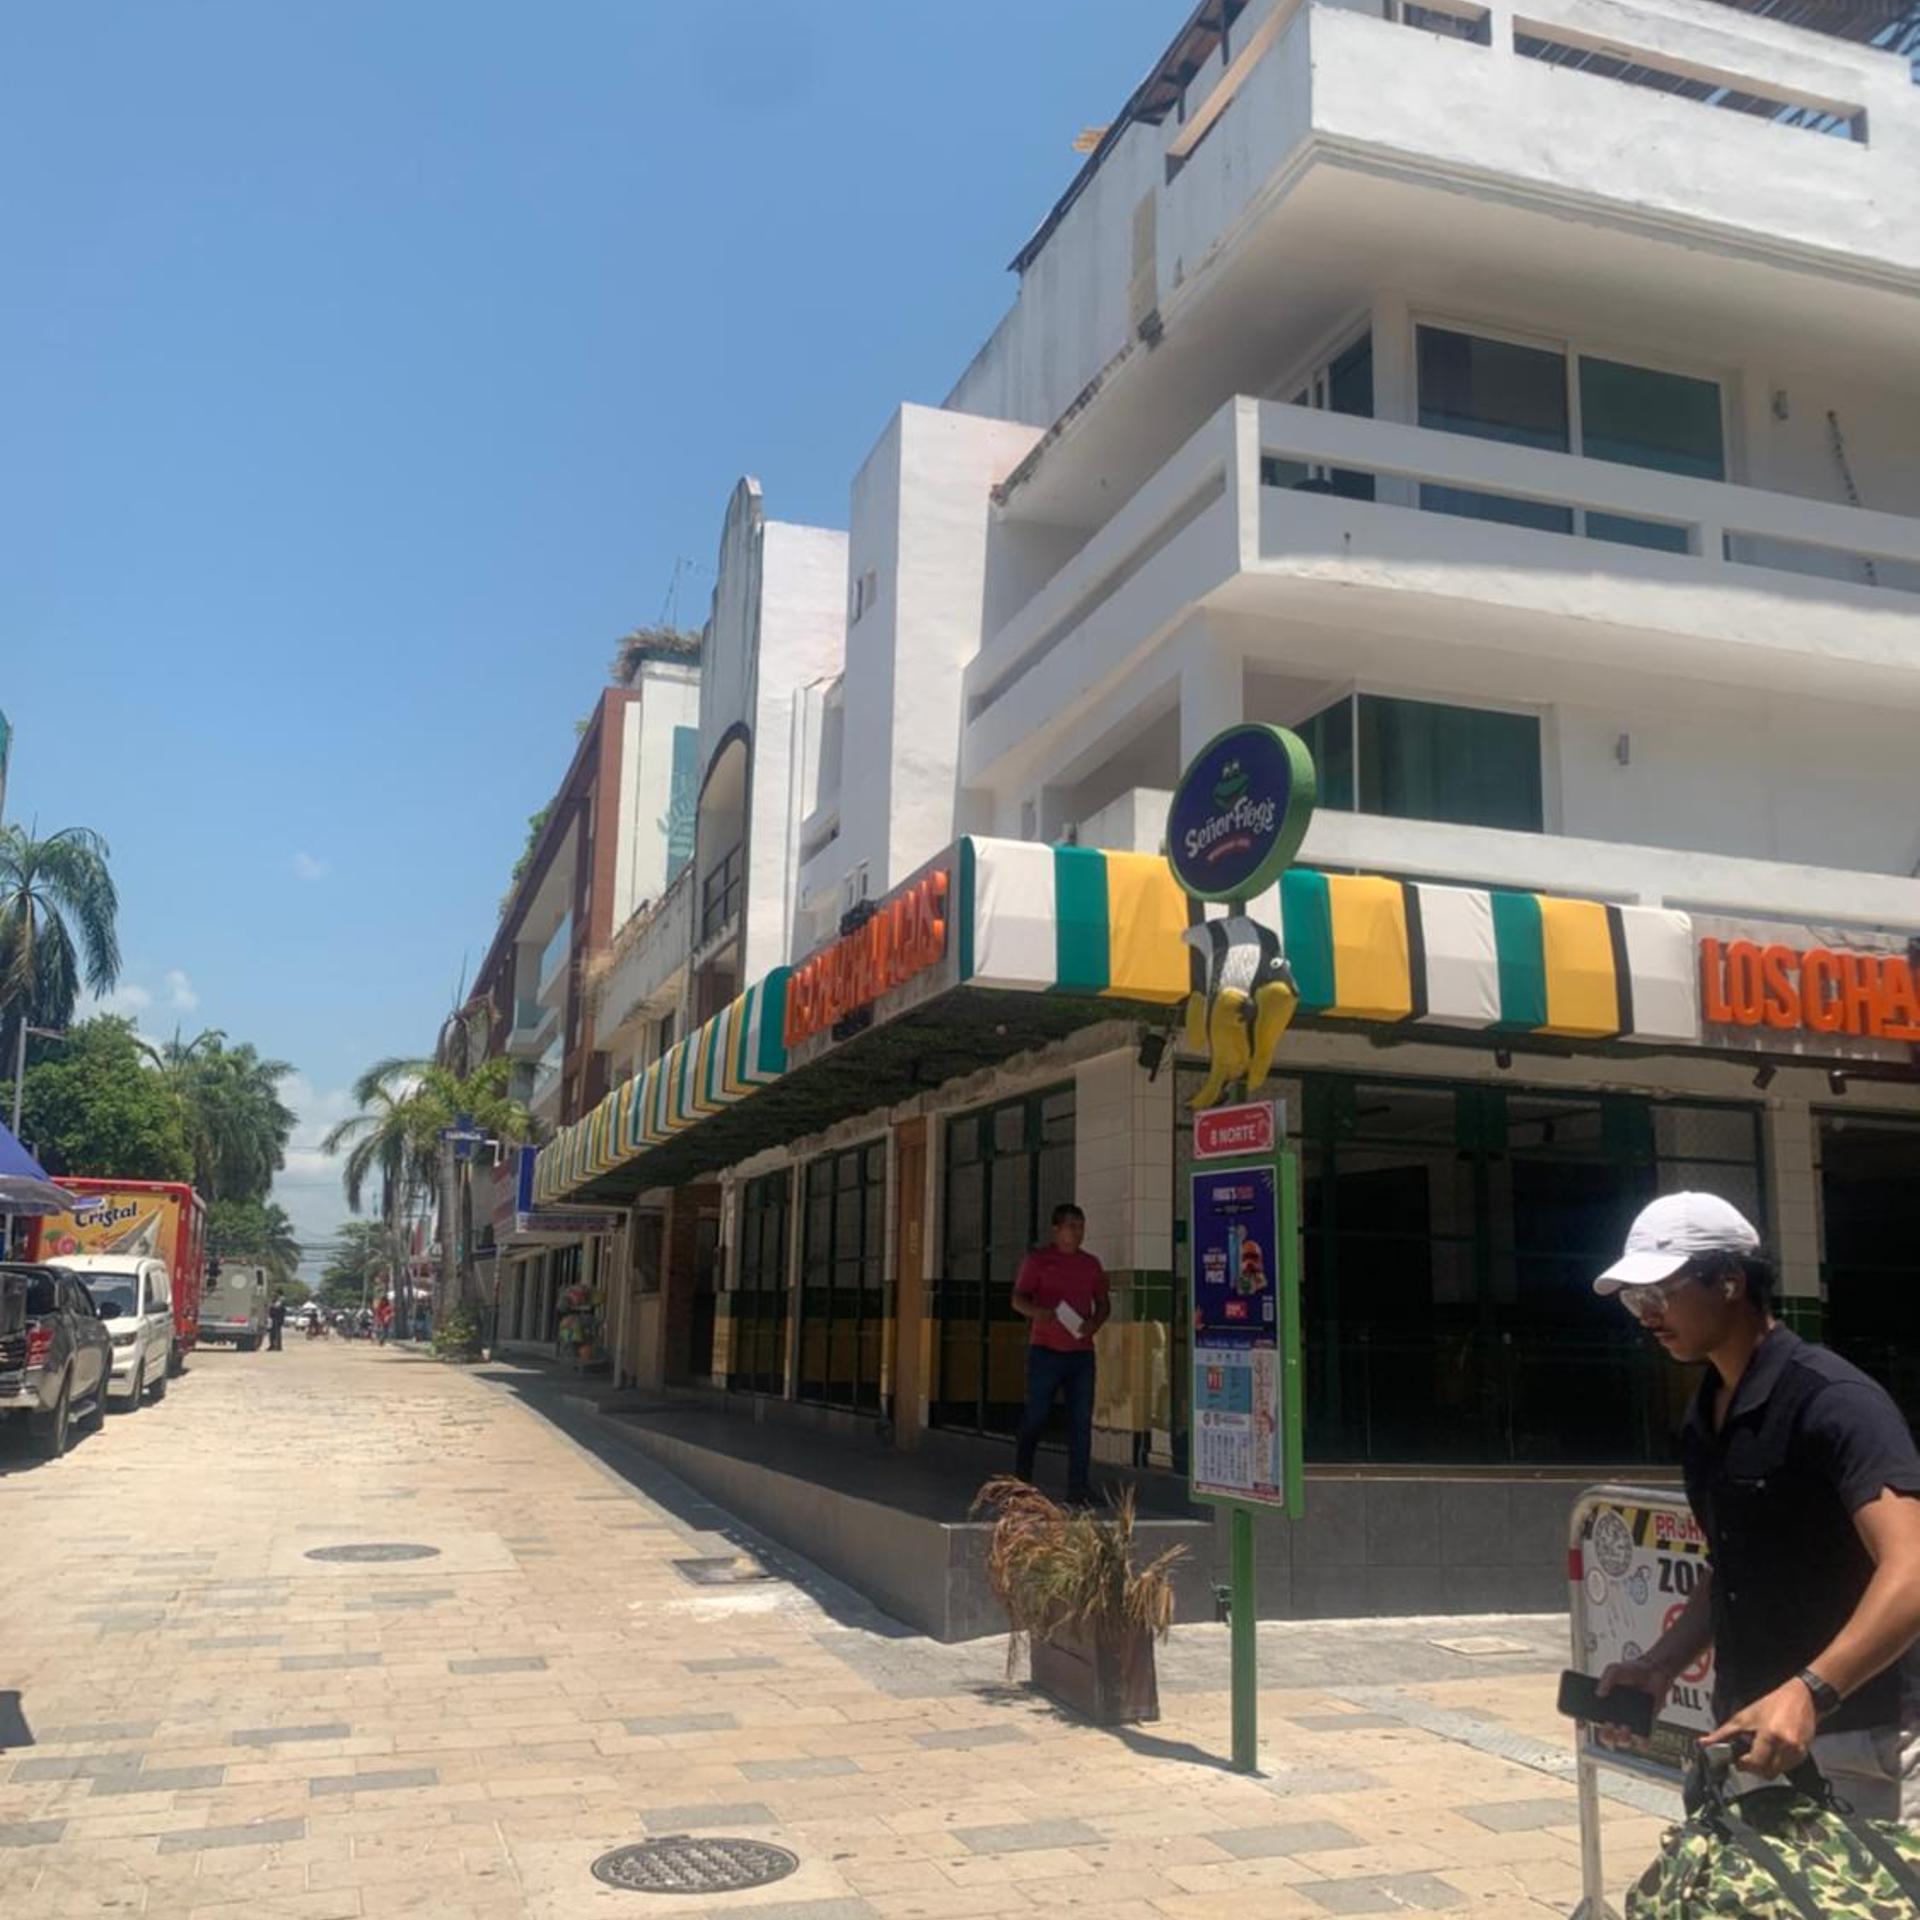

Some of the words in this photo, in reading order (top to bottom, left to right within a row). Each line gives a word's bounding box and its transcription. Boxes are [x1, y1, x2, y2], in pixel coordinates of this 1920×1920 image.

[1699, 935, 1801, 1030] LOS
[1218, 1124, 1257, 1145] NORTE
[74, 1201, 137, 1228] Cristal
